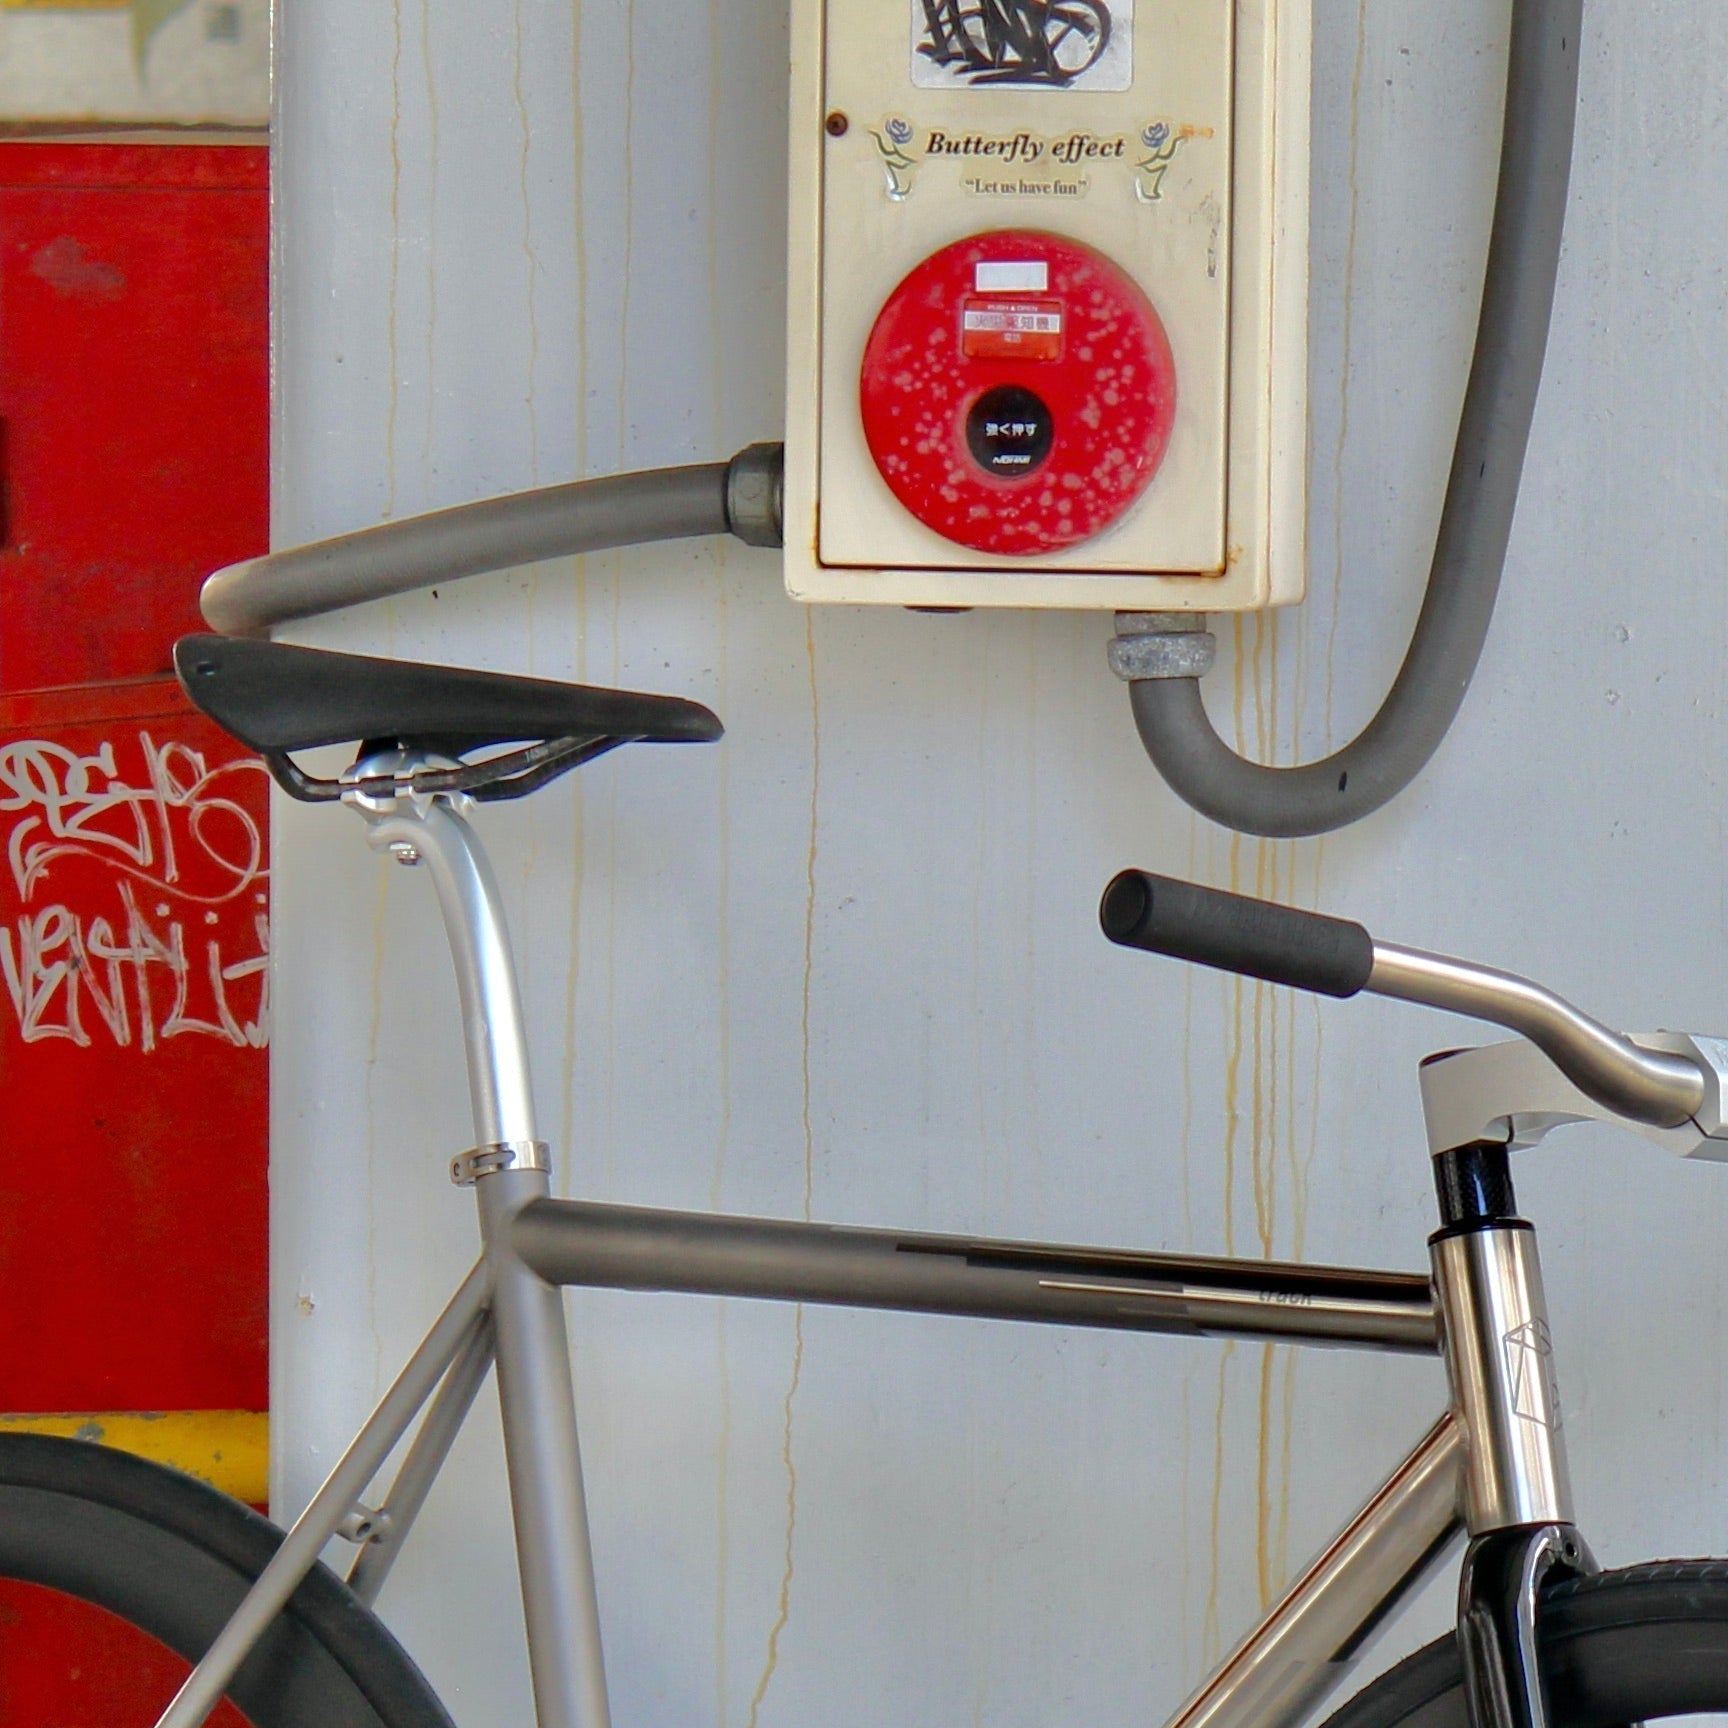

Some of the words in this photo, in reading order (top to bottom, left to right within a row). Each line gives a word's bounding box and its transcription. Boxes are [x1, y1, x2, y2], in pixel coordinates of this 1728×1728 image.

[925, 131, 1044, 163] Butterfly
[1051, 134, 1126, 164] effect
[1000, 181, 1017, 194] us
[1018, 178, 1052, 195] have
